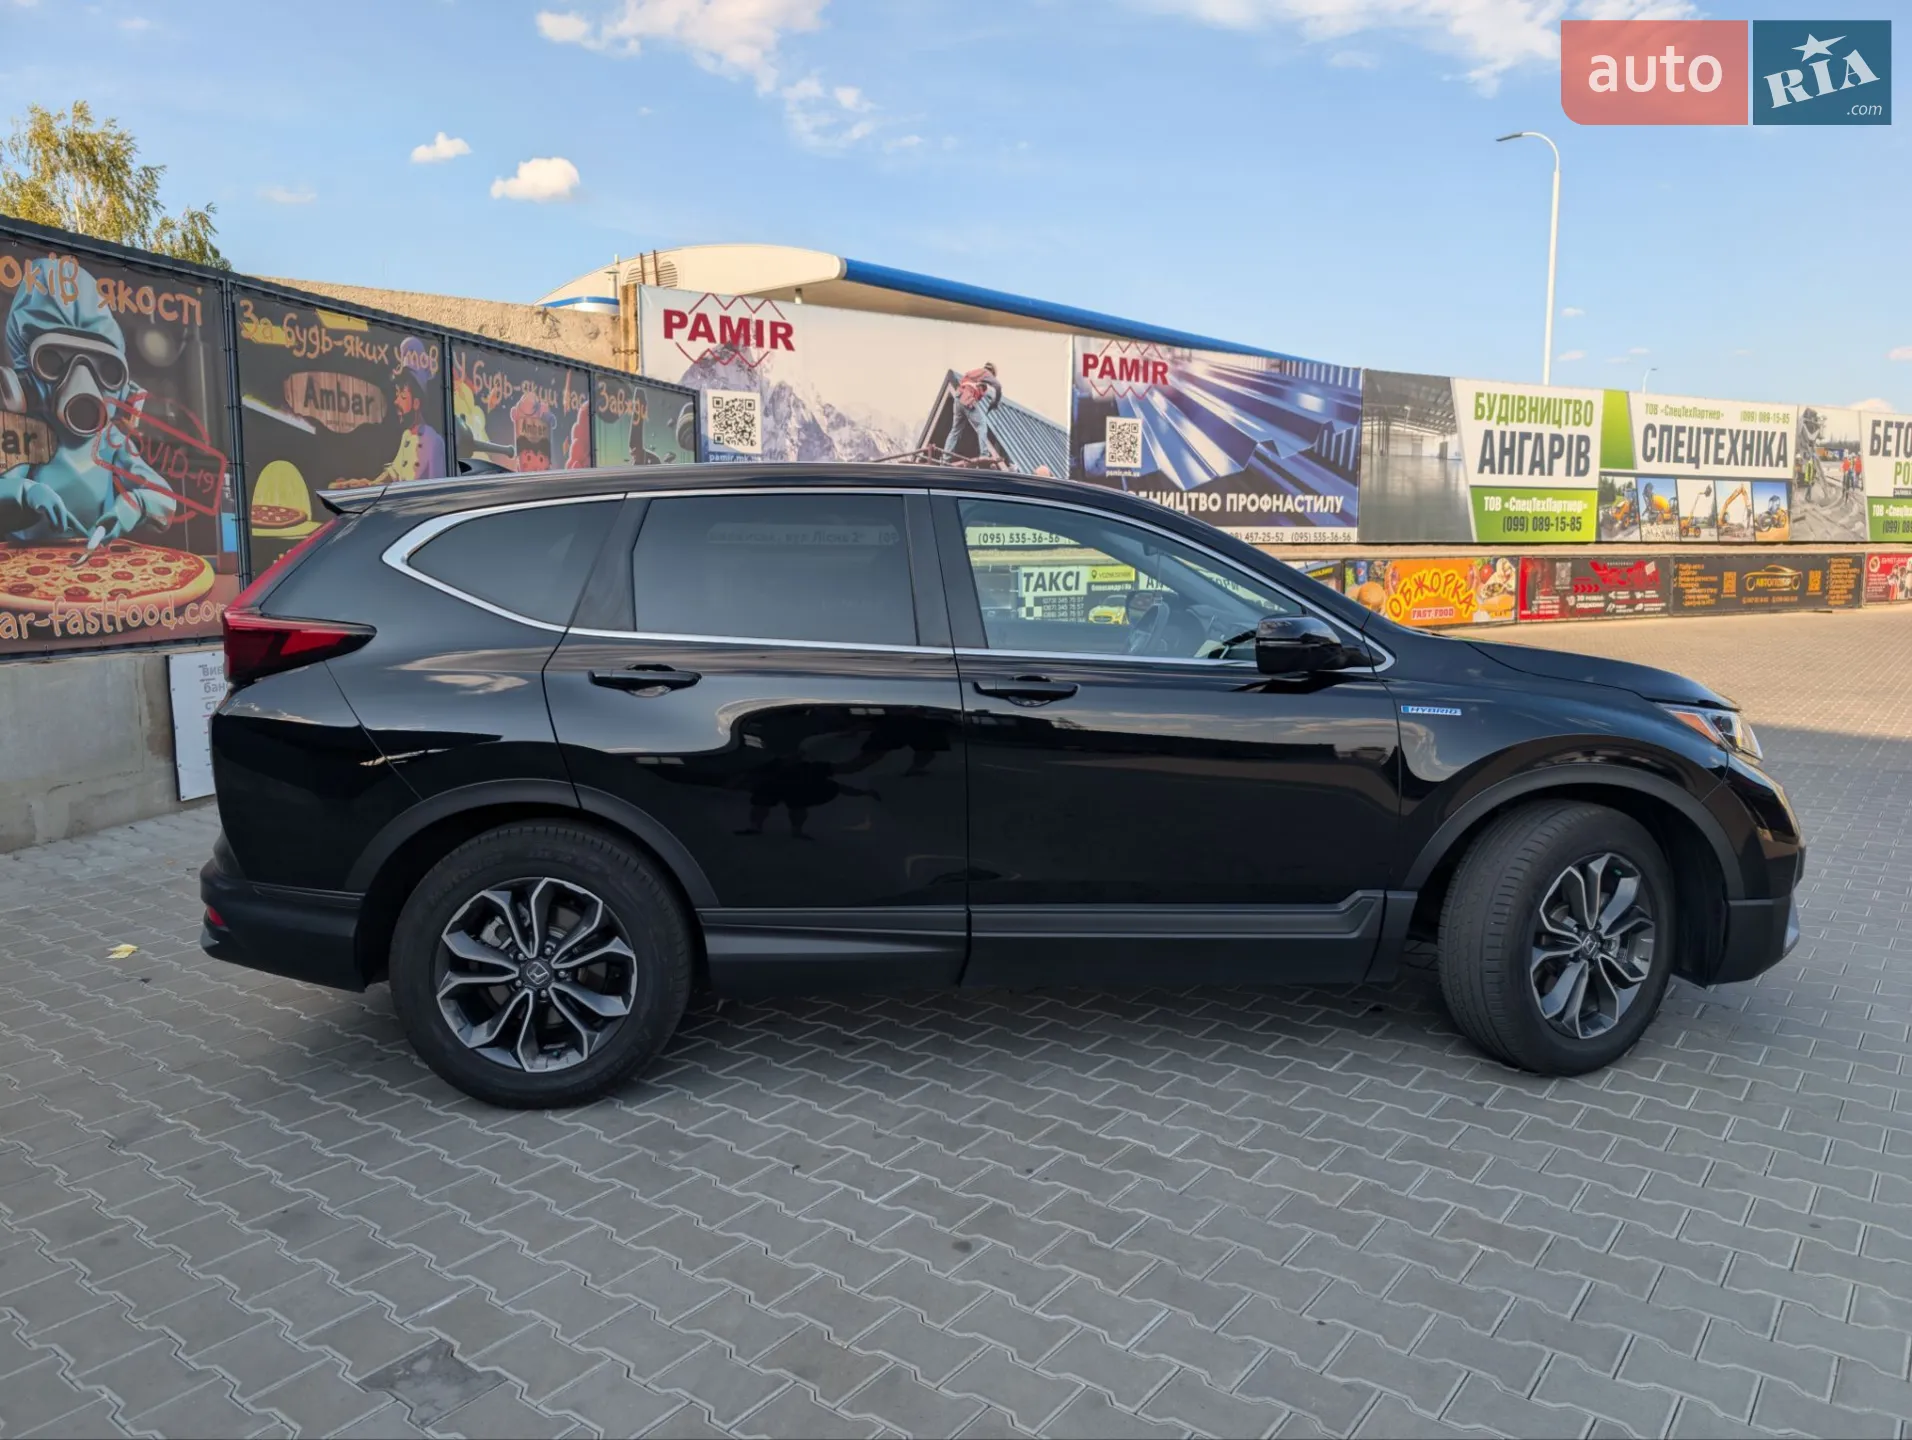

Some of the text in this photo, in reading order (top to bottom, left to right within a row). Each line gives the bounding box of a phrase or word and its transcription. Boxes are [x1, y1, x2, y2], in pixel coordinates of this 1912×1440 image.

[663, 308, 796, 351] PAMIR
[1082, 353, 1169, 385] PAMIR
[303, 375, 375, 417] Ambar
[1474, 391, 1594, 428] БУДІВНИЦТВО
[1645, 403, 1658, 415] ТОВ
[1477, 429, 1591, 477] АНГАРІВ
[1642, 423, 1788, 469] СПЕЦТЕХНІКА
[106, 421, 215, 494] COVID-19
[1226, 492, 1344, 514] ПРОФНАСТИЛУ
[1484, 496, 1502, 512] ТОВ
[1502, 516, 1582, 533] (099) 089-15-85
[978, 532, 1060, 545] (095) 535-36-56
[1245, 532, 1284, 541] 457-25-52
[1291, 532, 1352, 542] (095) 535-36-56
[1023, 570, 1081, 593] ТАКСІ
[1388, 570, 1477, 618] ОБЖОРКА
[1412, 608, 1454, 619] FAST FOOD
[1410, 706, 1459, 714] HYBRID
